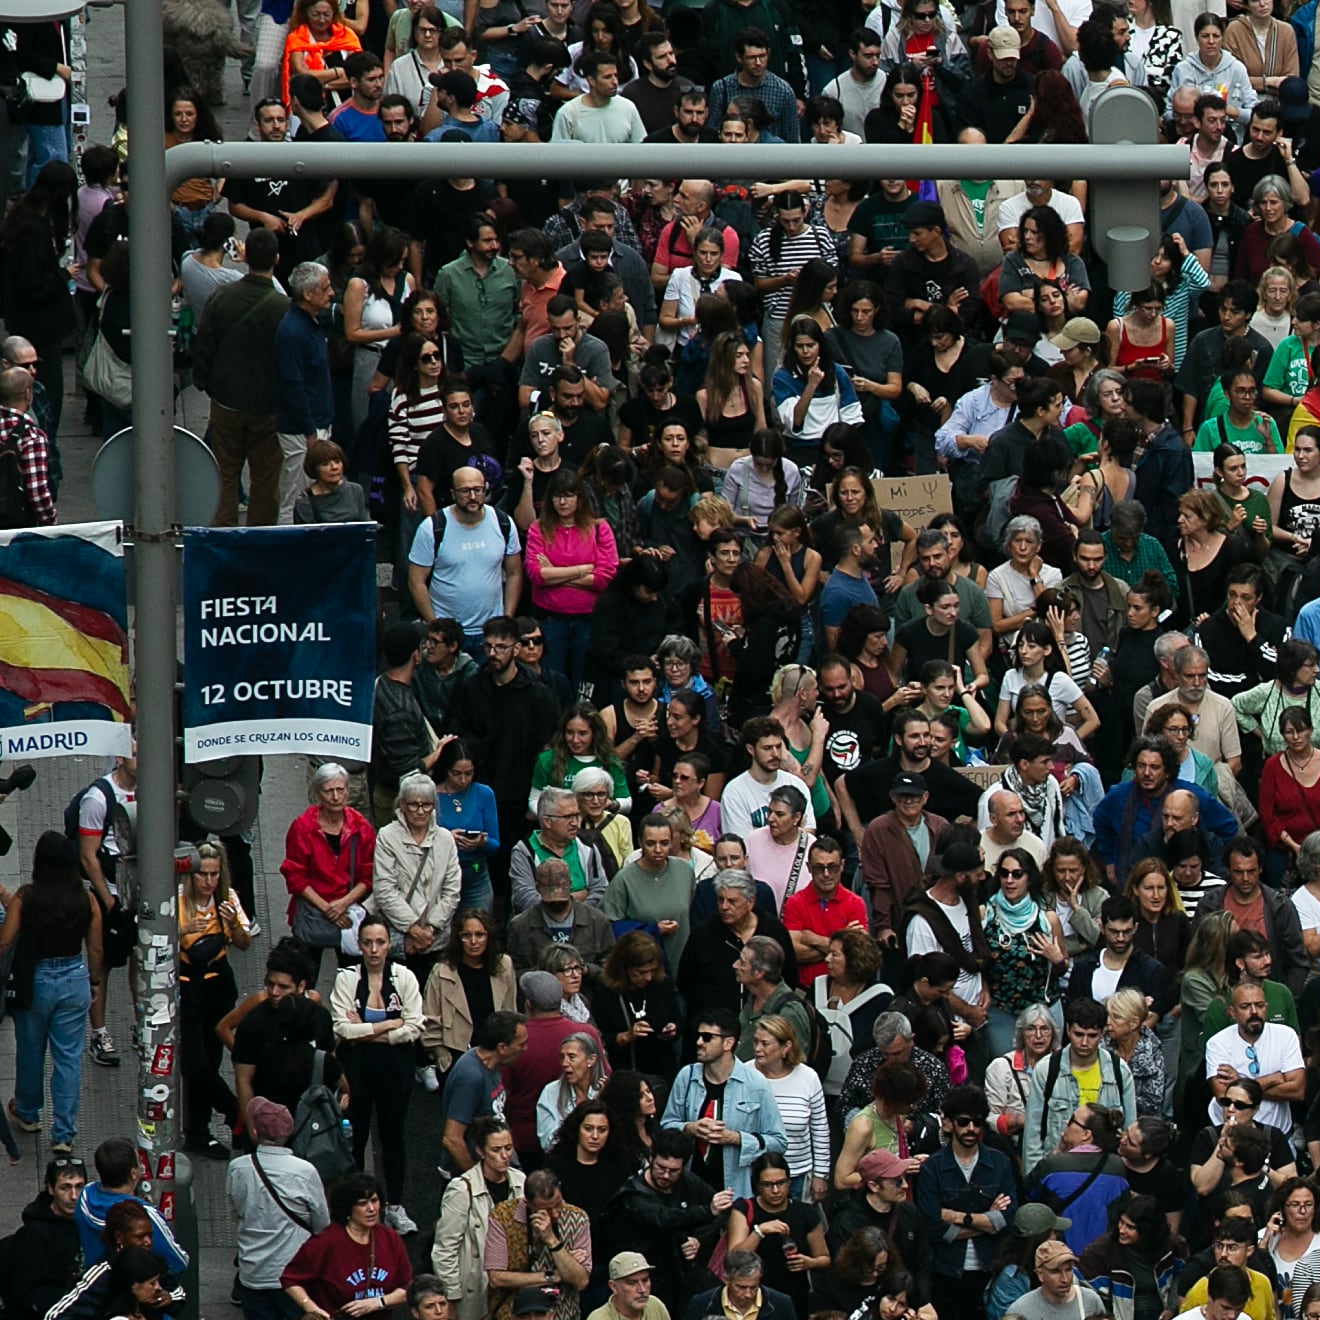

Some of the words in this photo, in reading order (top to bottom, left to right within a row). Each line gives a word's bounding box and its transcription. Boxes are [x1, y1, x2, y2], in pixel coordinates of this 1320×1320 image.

[201, 596, 277, 619] FIESTA
[201, 622, 331, 648] NACIONAL
[201, 684, 226, 705] 12
[233, 679, 353, 706] OCTUBRE
[10, 731, 90, 754] MADRID
[197, 735, 231, 748] DONDE
[234, 734, 246, 743] SE
[249, 732, 291, 744] CRUZAN
[295, 732, 313, 742] LOS
[317, 733, 361, 747] CAMINOS
[346, 1269, 366, 1286] THE
